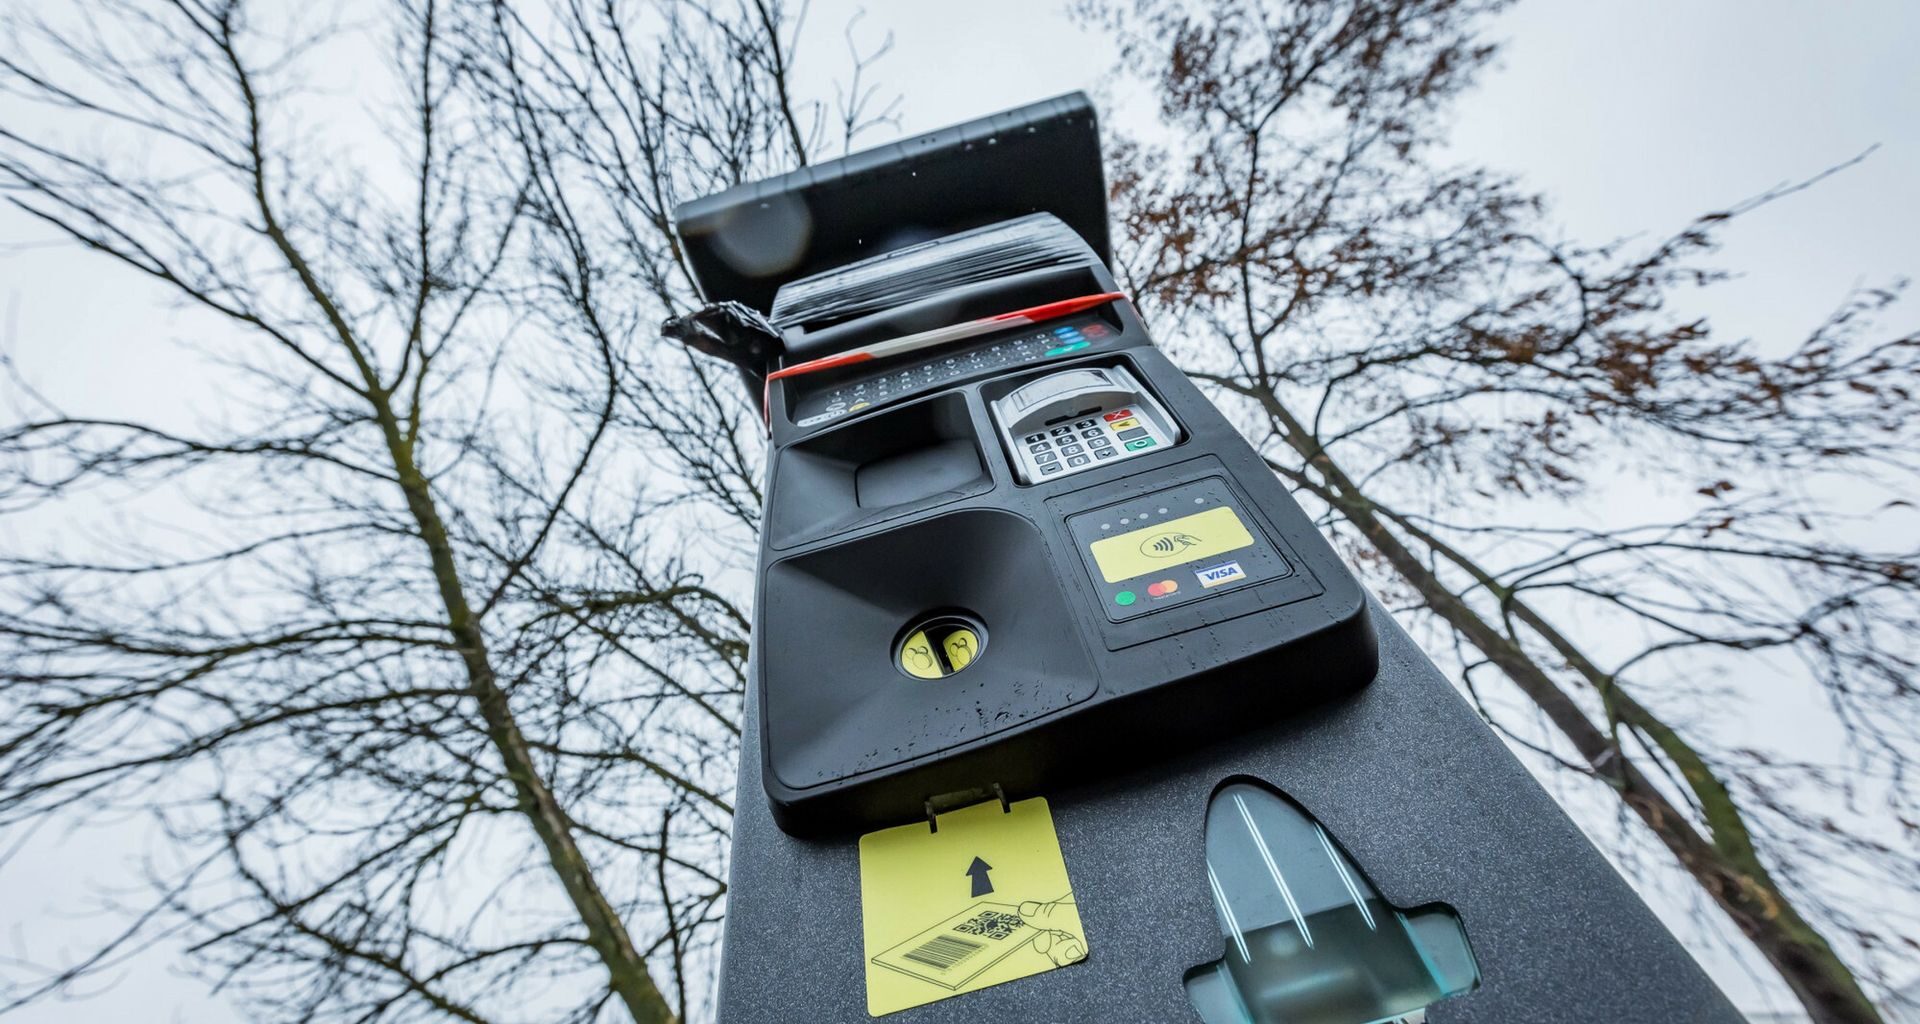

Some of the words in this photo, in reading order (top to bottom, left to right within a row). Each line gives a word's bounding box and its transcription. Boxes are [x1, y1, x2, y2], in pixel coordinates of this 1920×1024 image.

[1067, 446, 1078, 454] 8
[1074, 457, 1085, 465] 0
[1205, 566, 1238, 580] VISA
